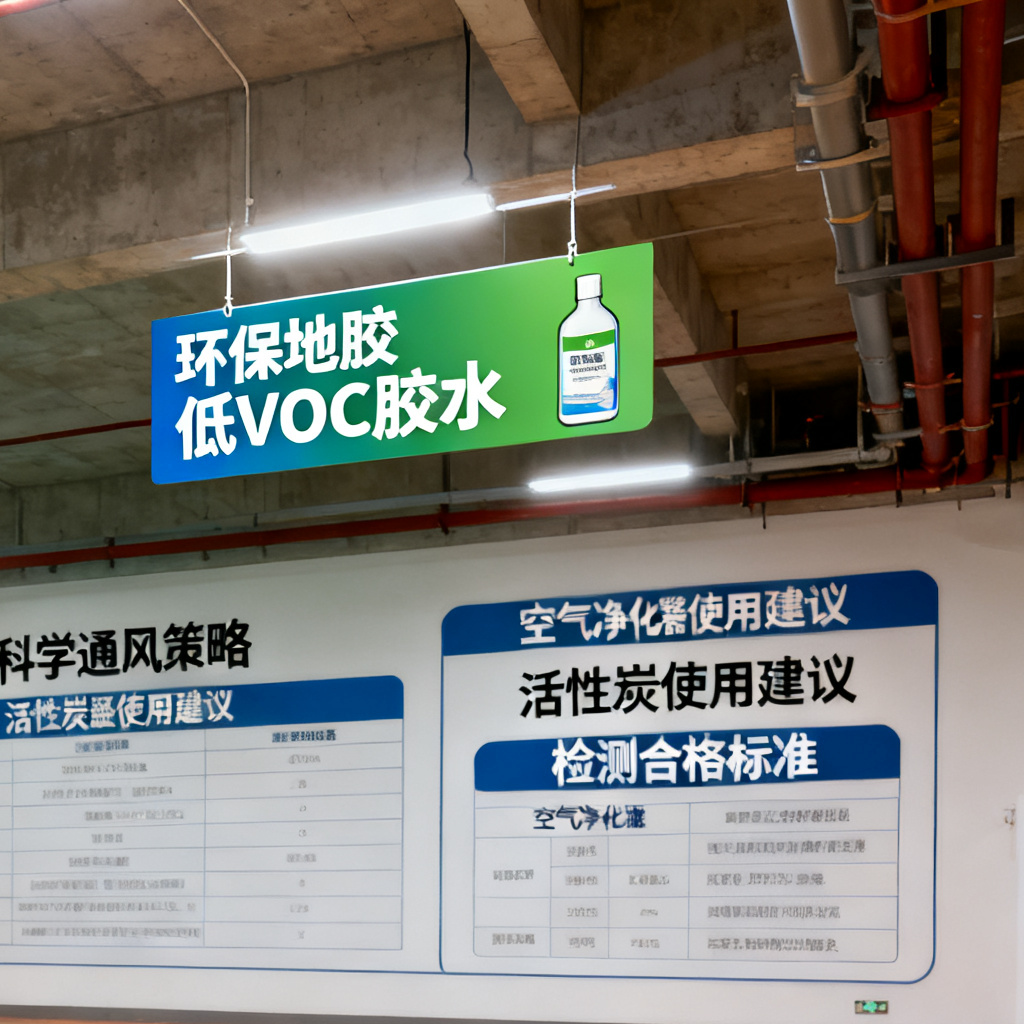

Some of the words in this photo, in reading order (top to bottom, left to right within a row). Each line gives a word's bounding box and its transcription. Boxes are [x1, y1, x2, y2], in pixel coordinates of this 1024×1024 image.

[175, 305, 399, 386] 环保地胶
[175, 361, 507, 460] 低VOC胶水
[519, 653, 857, 718] 活性炭使用建议
[551, 732, 818, 787] 检测合格标准
